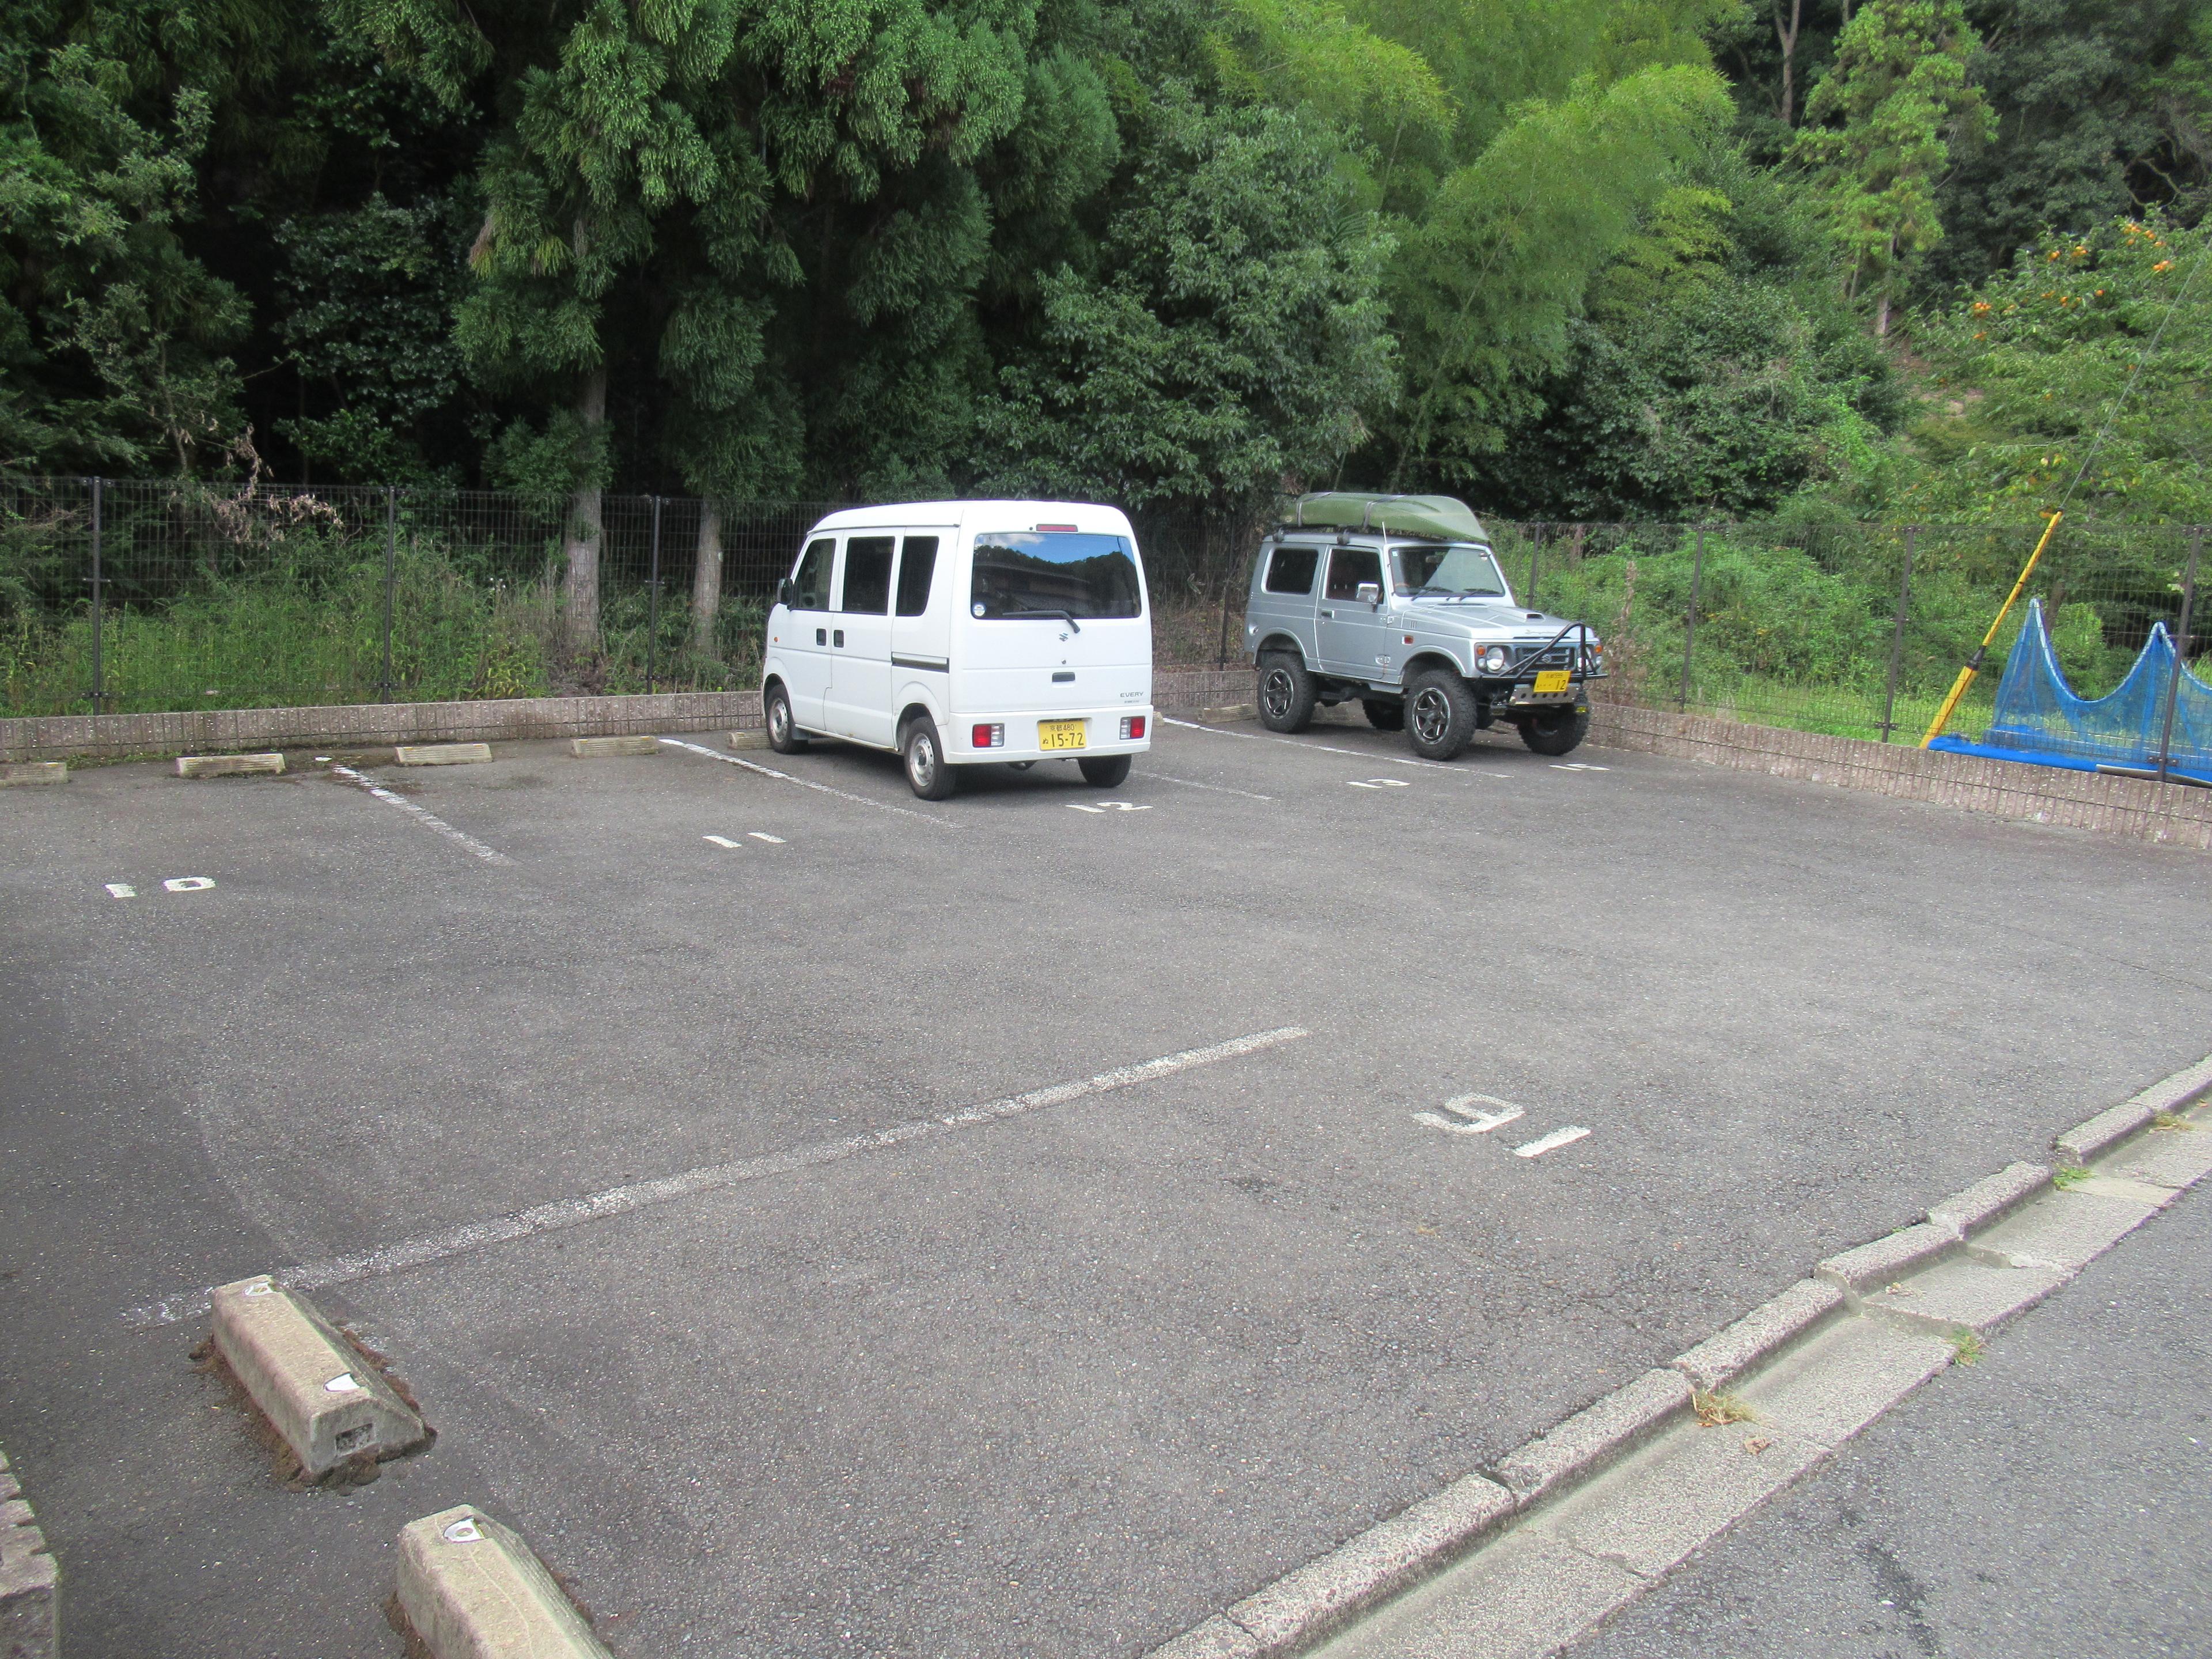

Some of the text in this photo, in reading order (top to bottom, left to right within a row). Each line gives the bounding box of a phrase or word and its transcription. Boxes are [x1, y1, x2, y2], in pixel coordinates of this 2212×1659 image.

[1051, 732, 1084, 748] 15-72
[1065, 801, 1154, 813] 12
[702, 834, 787, 849] 11
[104, 876, 217, 899] 10
